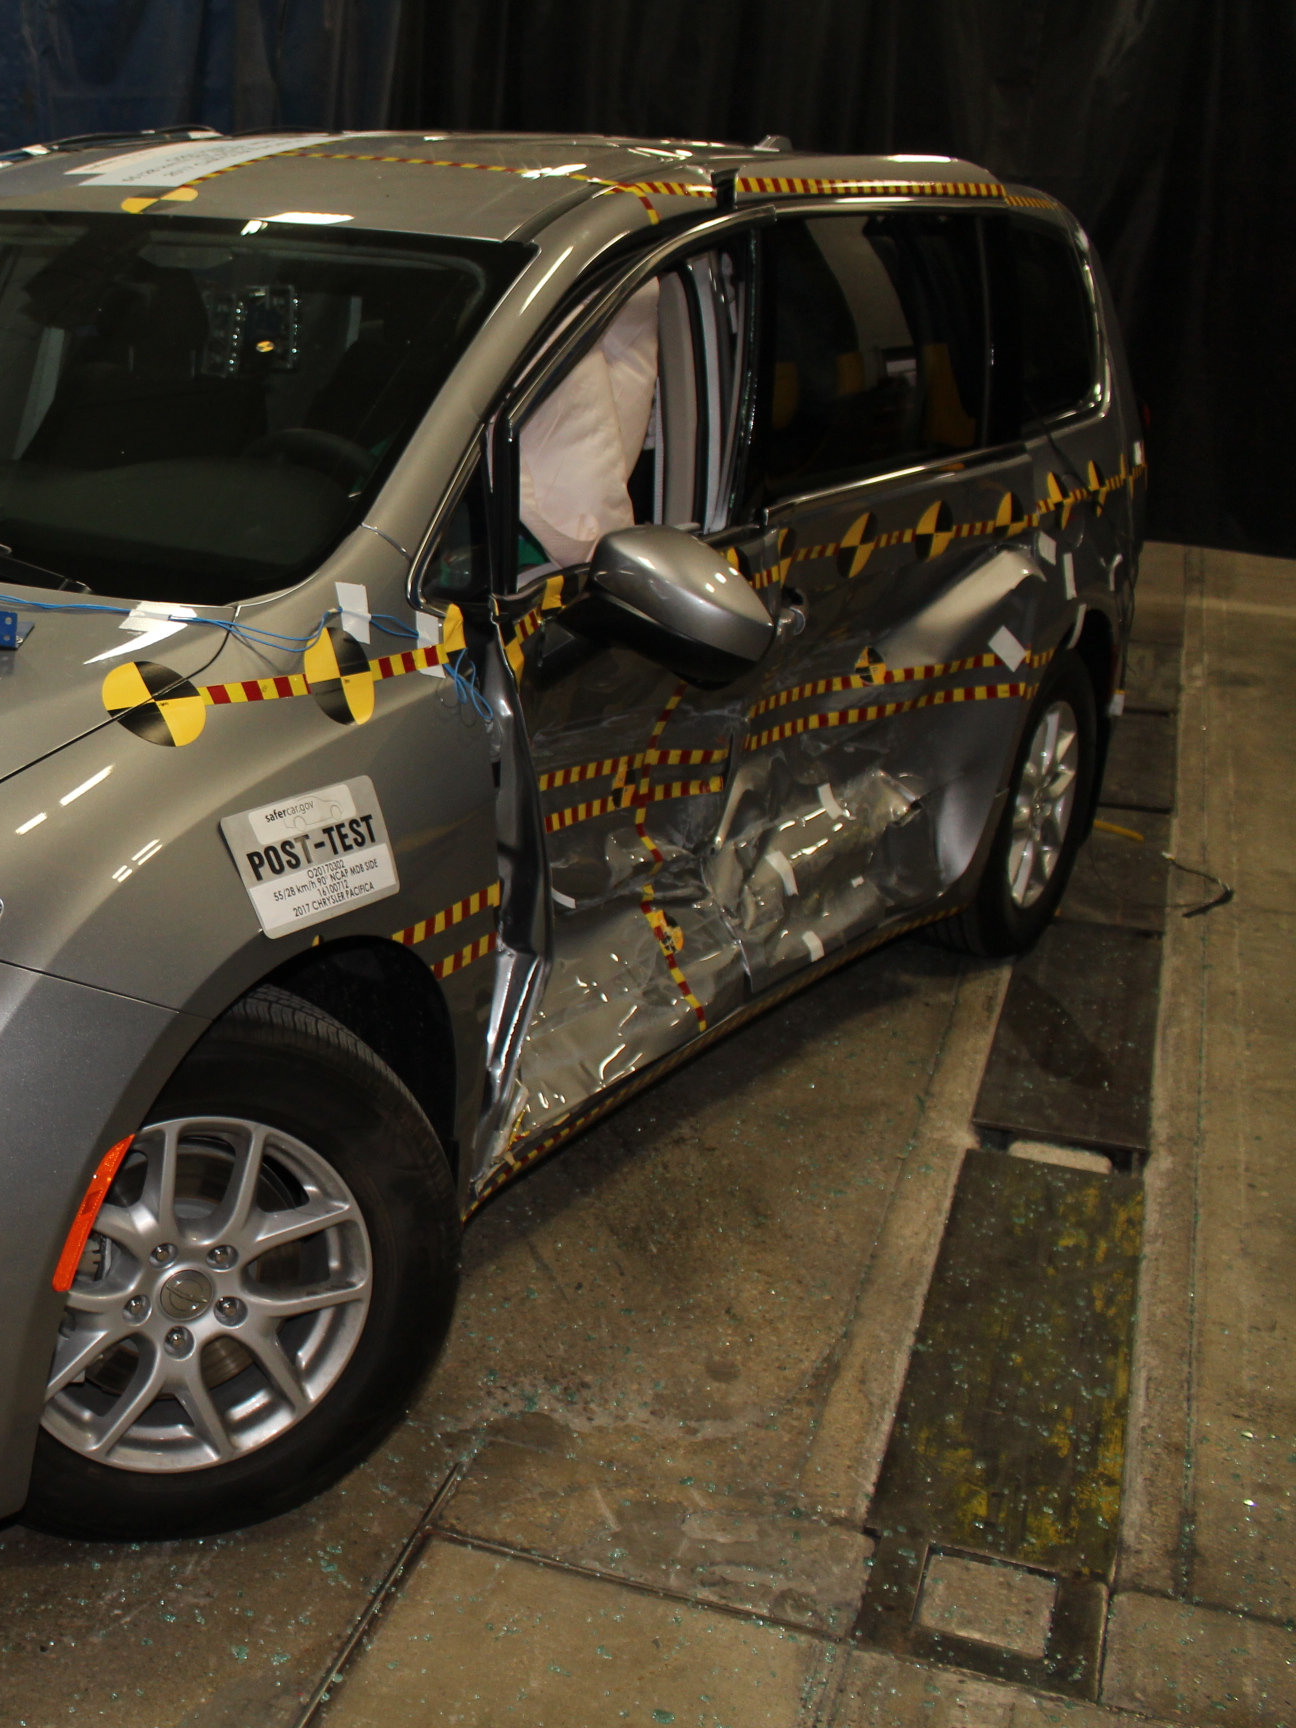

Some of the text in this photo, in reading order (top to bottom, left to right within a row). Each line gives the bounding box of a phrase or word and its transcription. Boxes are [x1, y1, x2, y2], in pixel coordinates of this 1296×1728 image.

[265, 800, 314, 823] safercar.gov
[246, 814, 376, 881] POST-TEST
[273, 886, 297, 902] 55/28
[297, 879, 317, 894] km/h
[330, 868, 349, 882] NCAP
[350, 862, 365, 876] MDB
[364, 858, 379, 871] SIDE
[317, 879, 350, 898] 16100712
[293, 881, 375, 918] 2017 CHRYSLER PACIFICA
